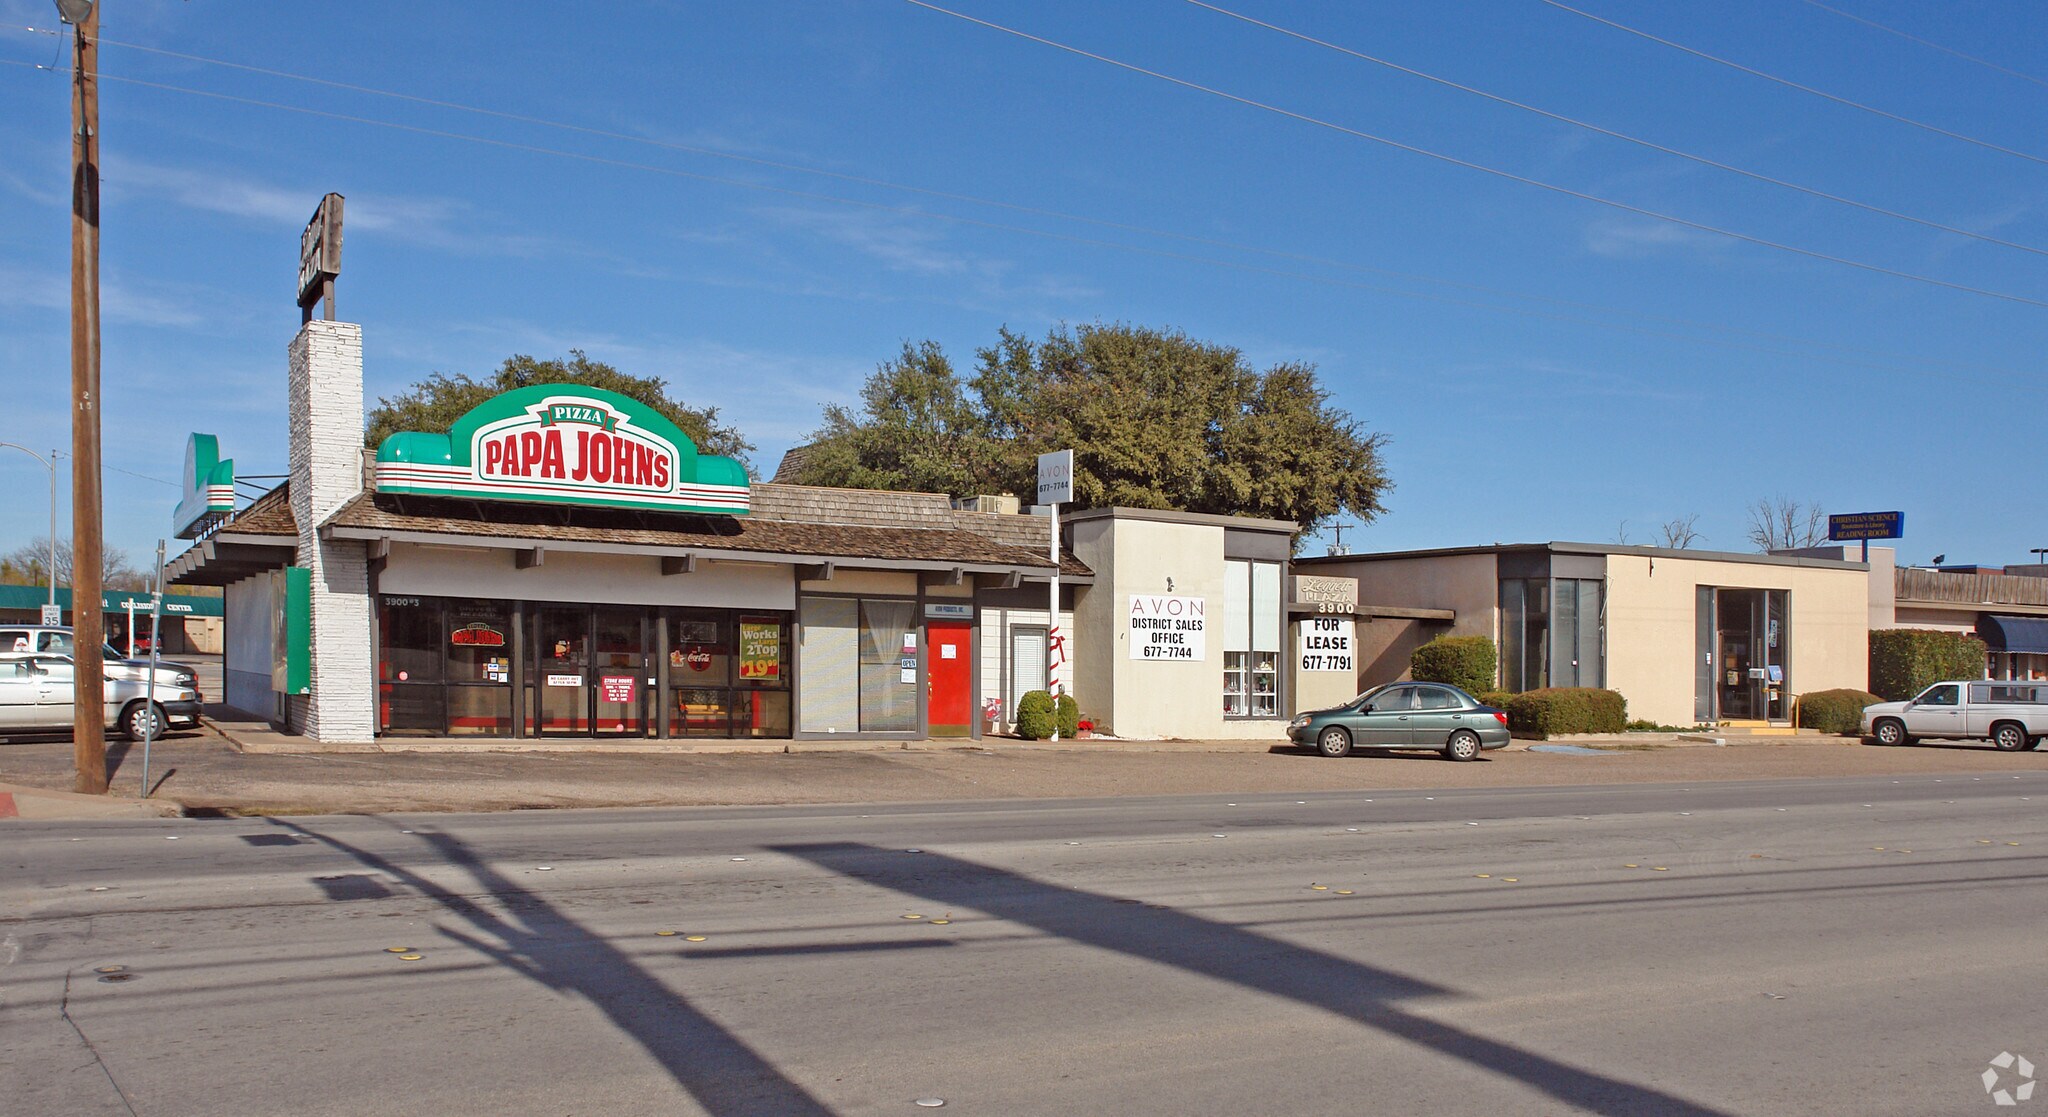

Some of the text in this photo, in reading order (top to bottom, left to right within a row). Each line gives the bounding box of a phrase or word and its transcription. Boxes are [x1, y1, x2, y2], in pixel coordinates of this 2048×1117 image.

[554, 406, 602, 423] PIZZA
[485, 430, 669, 488] PAPA JOHN'S
[1039, 464, 1069, 479] AVON
[1039, 480, 1069, 493] 677-7744
[1832, 513, 1897, 523] CHRISTIAN SCIENCE
[1837, 529, 1888, 539] READING ROOM
[1305, 592, 1352, 603] PLAZA
[1131, 598, 1204, 617] AVON
[1318, 603, 1355, 614] 3900
[44, 616, 59, 626] 35
[1132, 617, 1203, 631] DISTRICT SALES
[1314, 617, 1340, 631] FOR
[742, 629, 778, 640] Works
[1151, 632, 1185, 644] OFFICE
[1306, 636, 1348, 650] LEASE
[1143, 645, 1192, 658] 677-7744
[902, 659, 916, 667] OPEN
[1302, 654, 1352, 671] 677-7791
